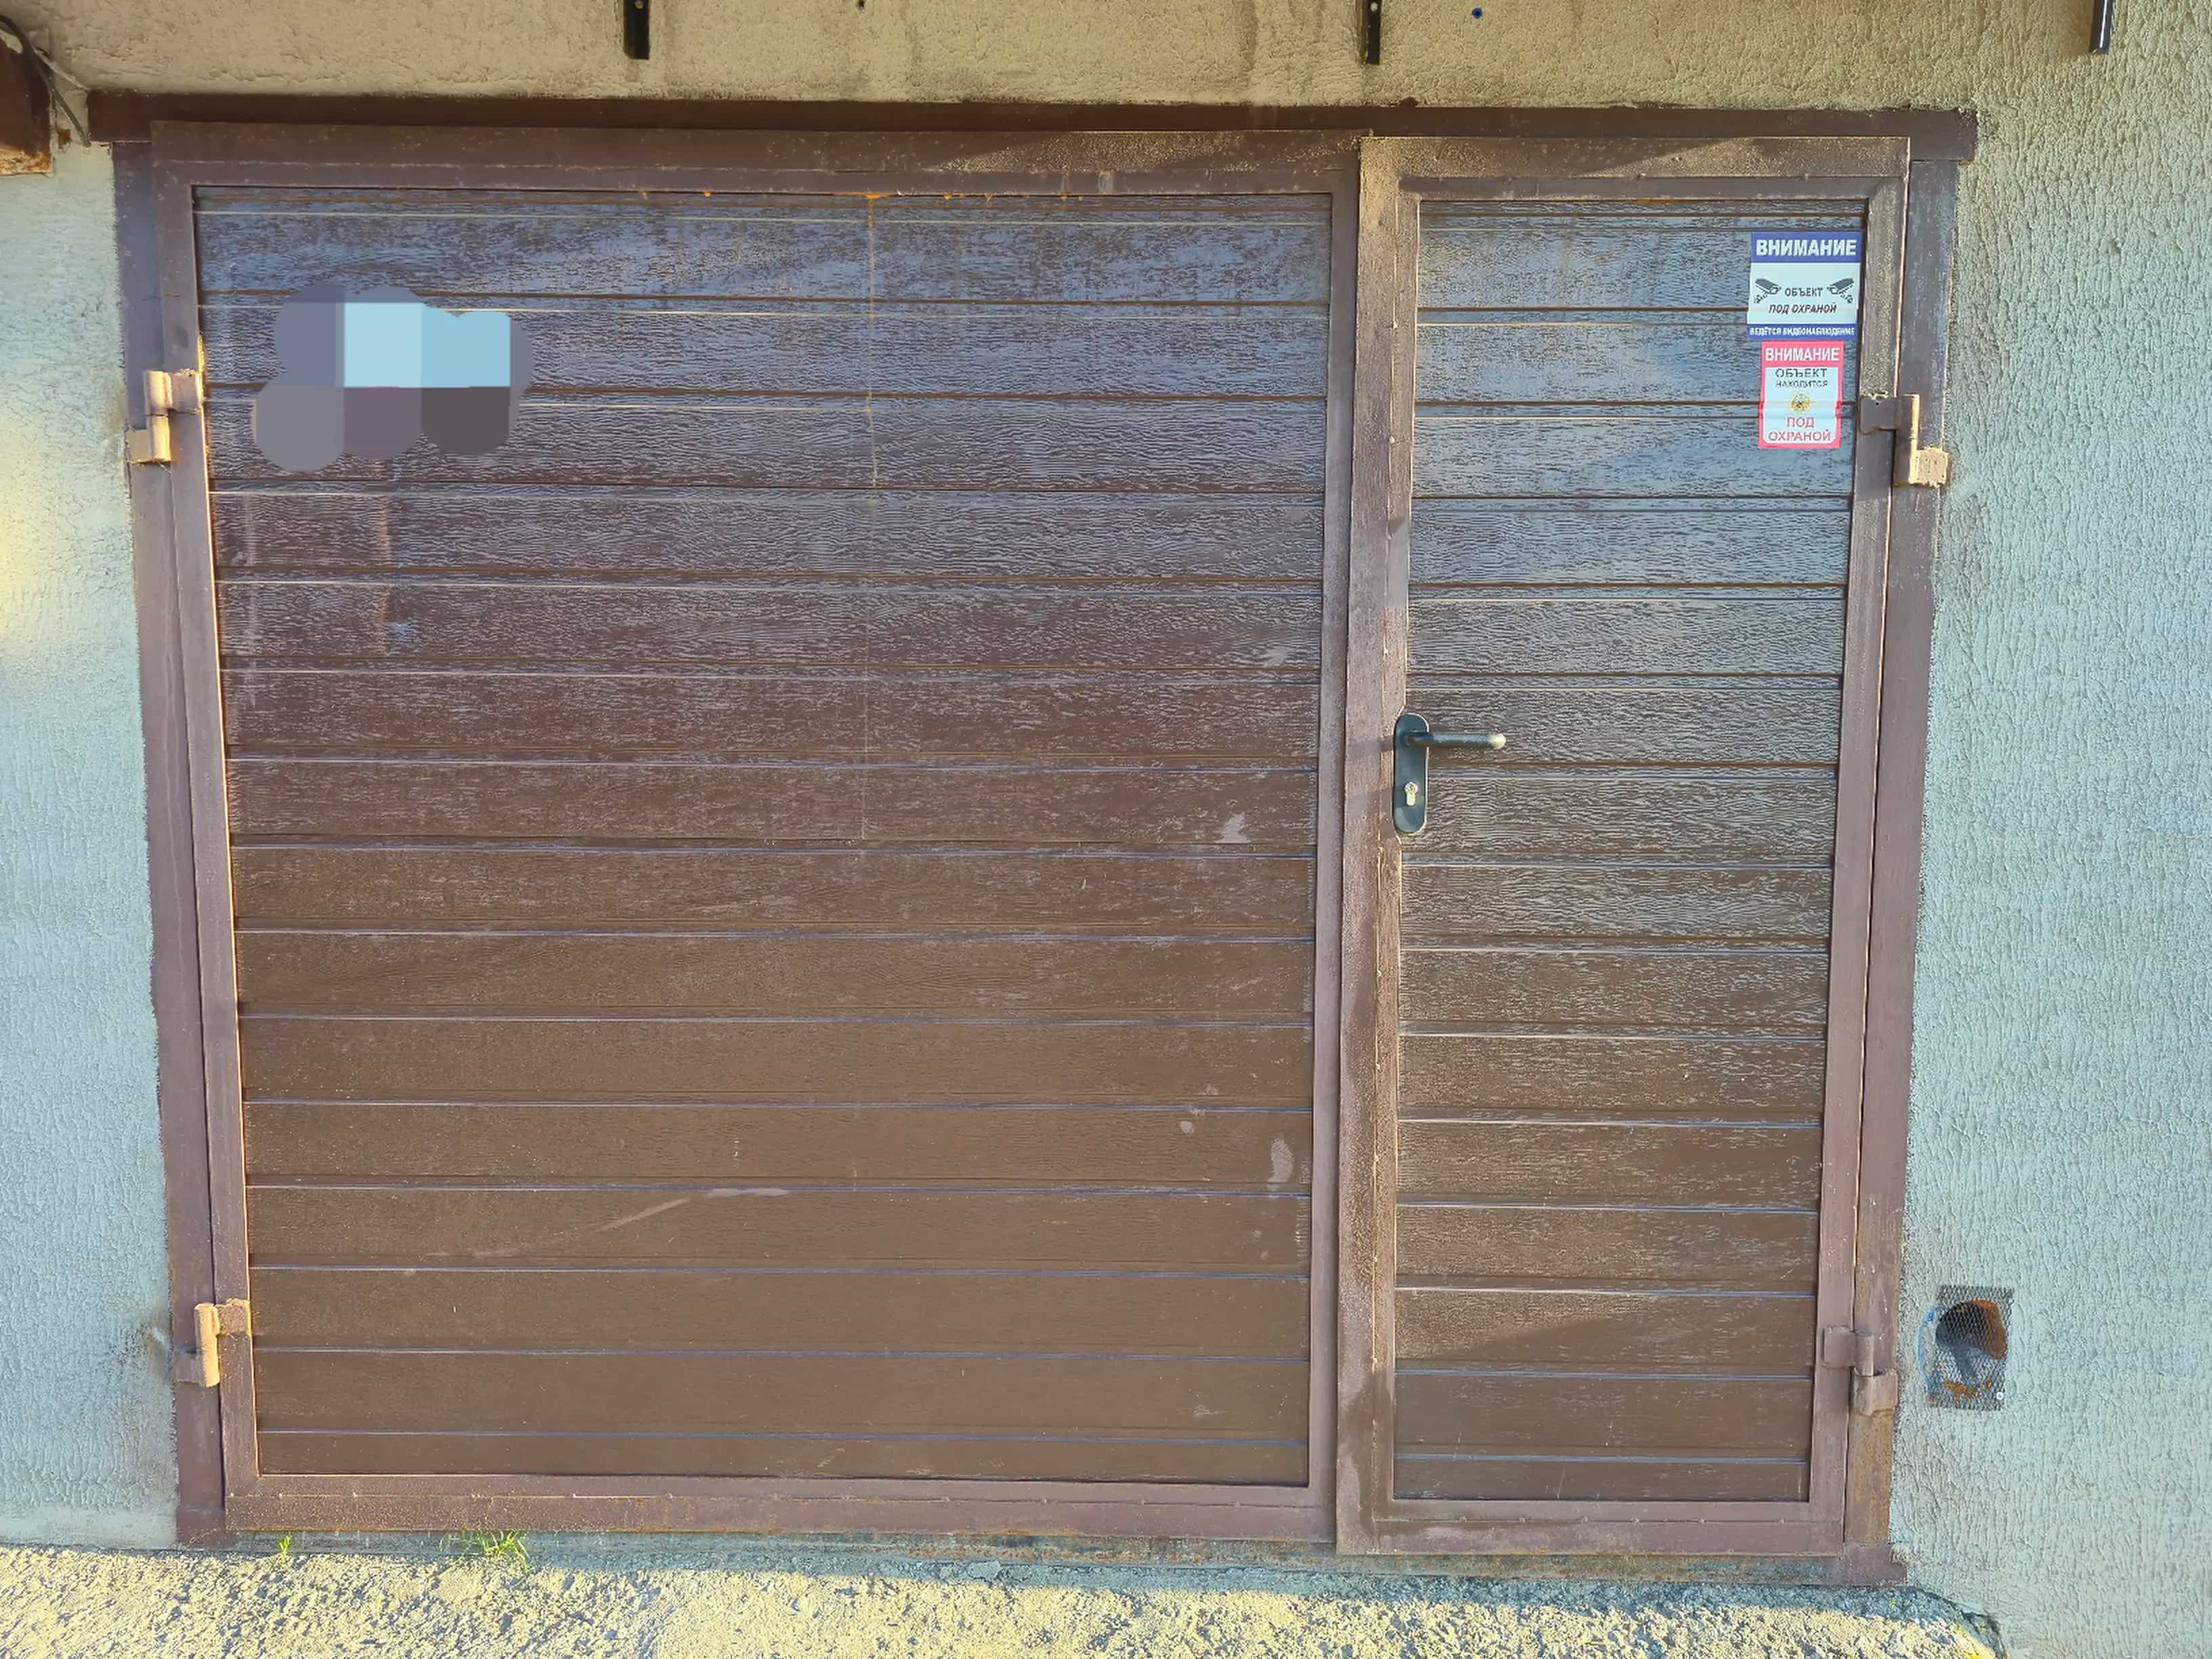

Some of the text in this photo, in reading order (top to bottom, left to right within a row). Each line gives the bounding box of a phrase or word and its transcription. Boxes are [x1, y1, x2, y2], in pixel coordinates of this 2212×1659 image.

[1756, 239, 1857, 256] ВНИМАНИЕ
[1784, 287, 1824, 297] ОБЪЕКТ
[1768, 302, 1837, 314] ПОД ОХРАНОЙ
[1765, 348, 1840, 361] ВНИМАНИЕ
[1775, 368, 1828, 377] ОБЪЕКТ
[1776, 380, 1828, 388] НАХОДИТСЯ
[1786, 417, 1814, 428] ПОД
[1768, 429, 1831, 441] ОХРАНОЙ
